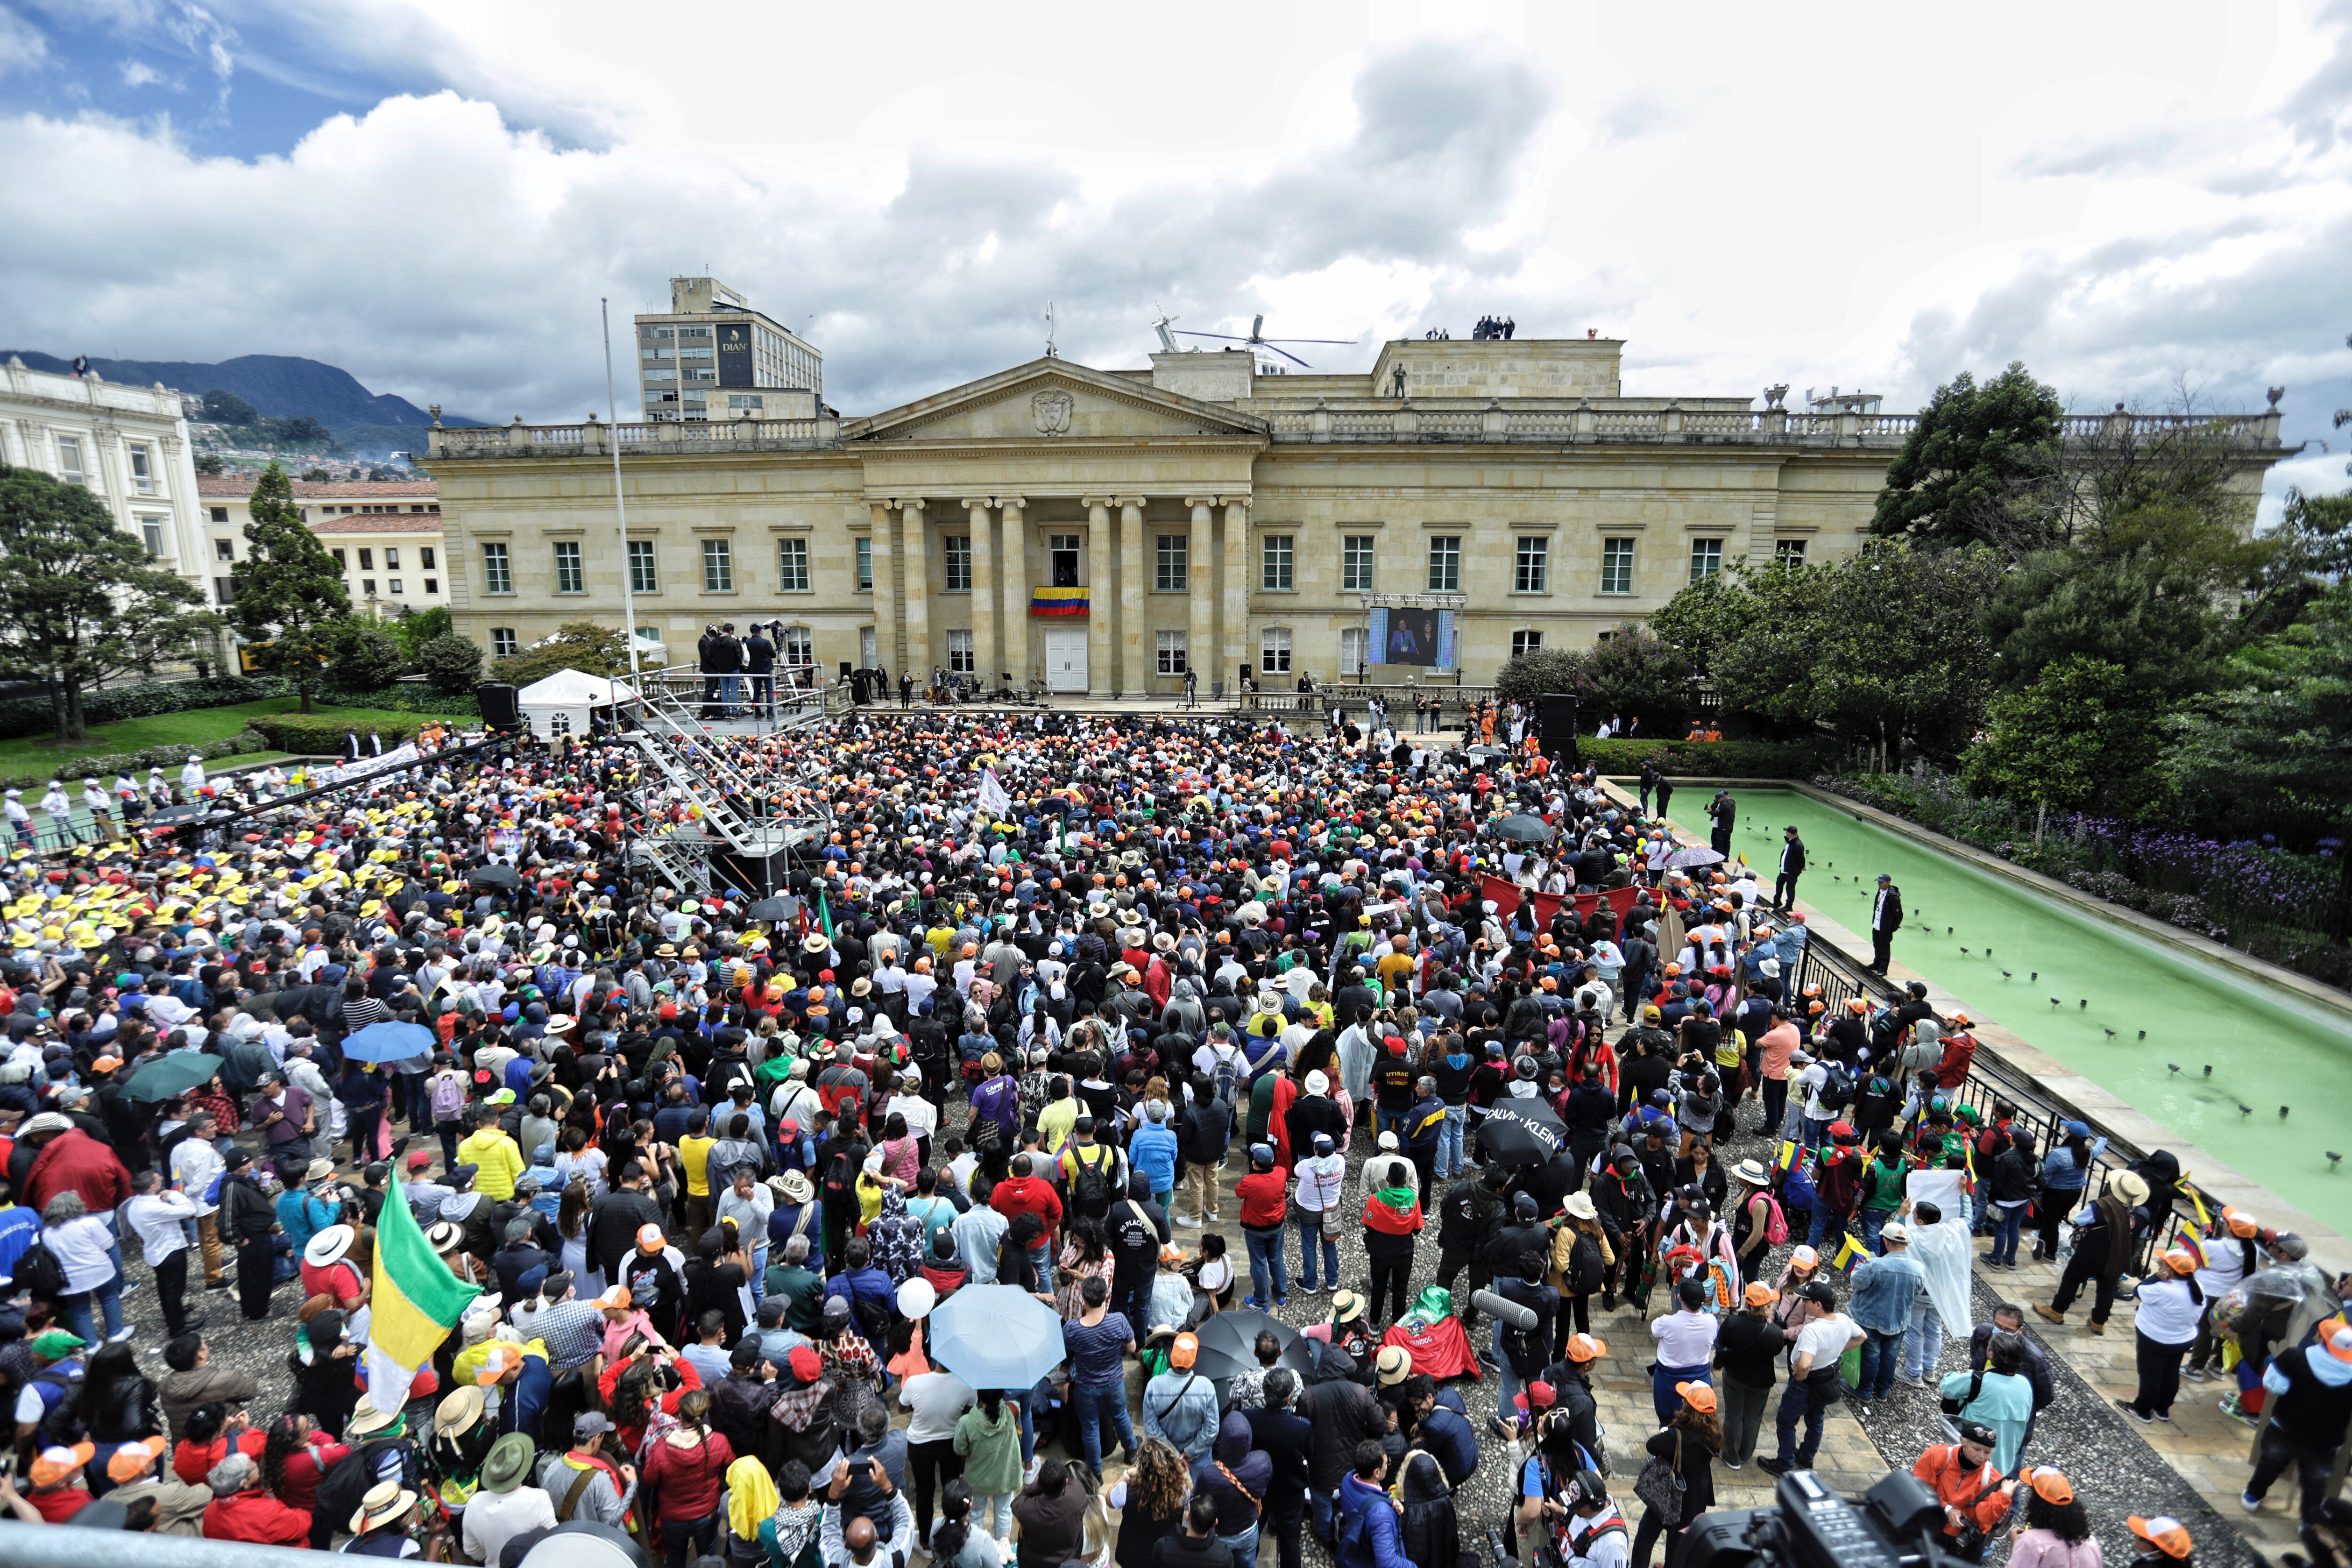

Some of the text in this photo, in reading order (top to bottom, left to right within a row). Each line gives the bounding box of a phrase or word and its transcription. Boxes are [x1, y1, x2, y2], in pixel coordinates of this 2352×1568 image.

[723, 343, 746, 351] DIAN
[1524, 1118, 1560, 1149] KLEIN
[1120, 1225, 1127, 1233] NO
